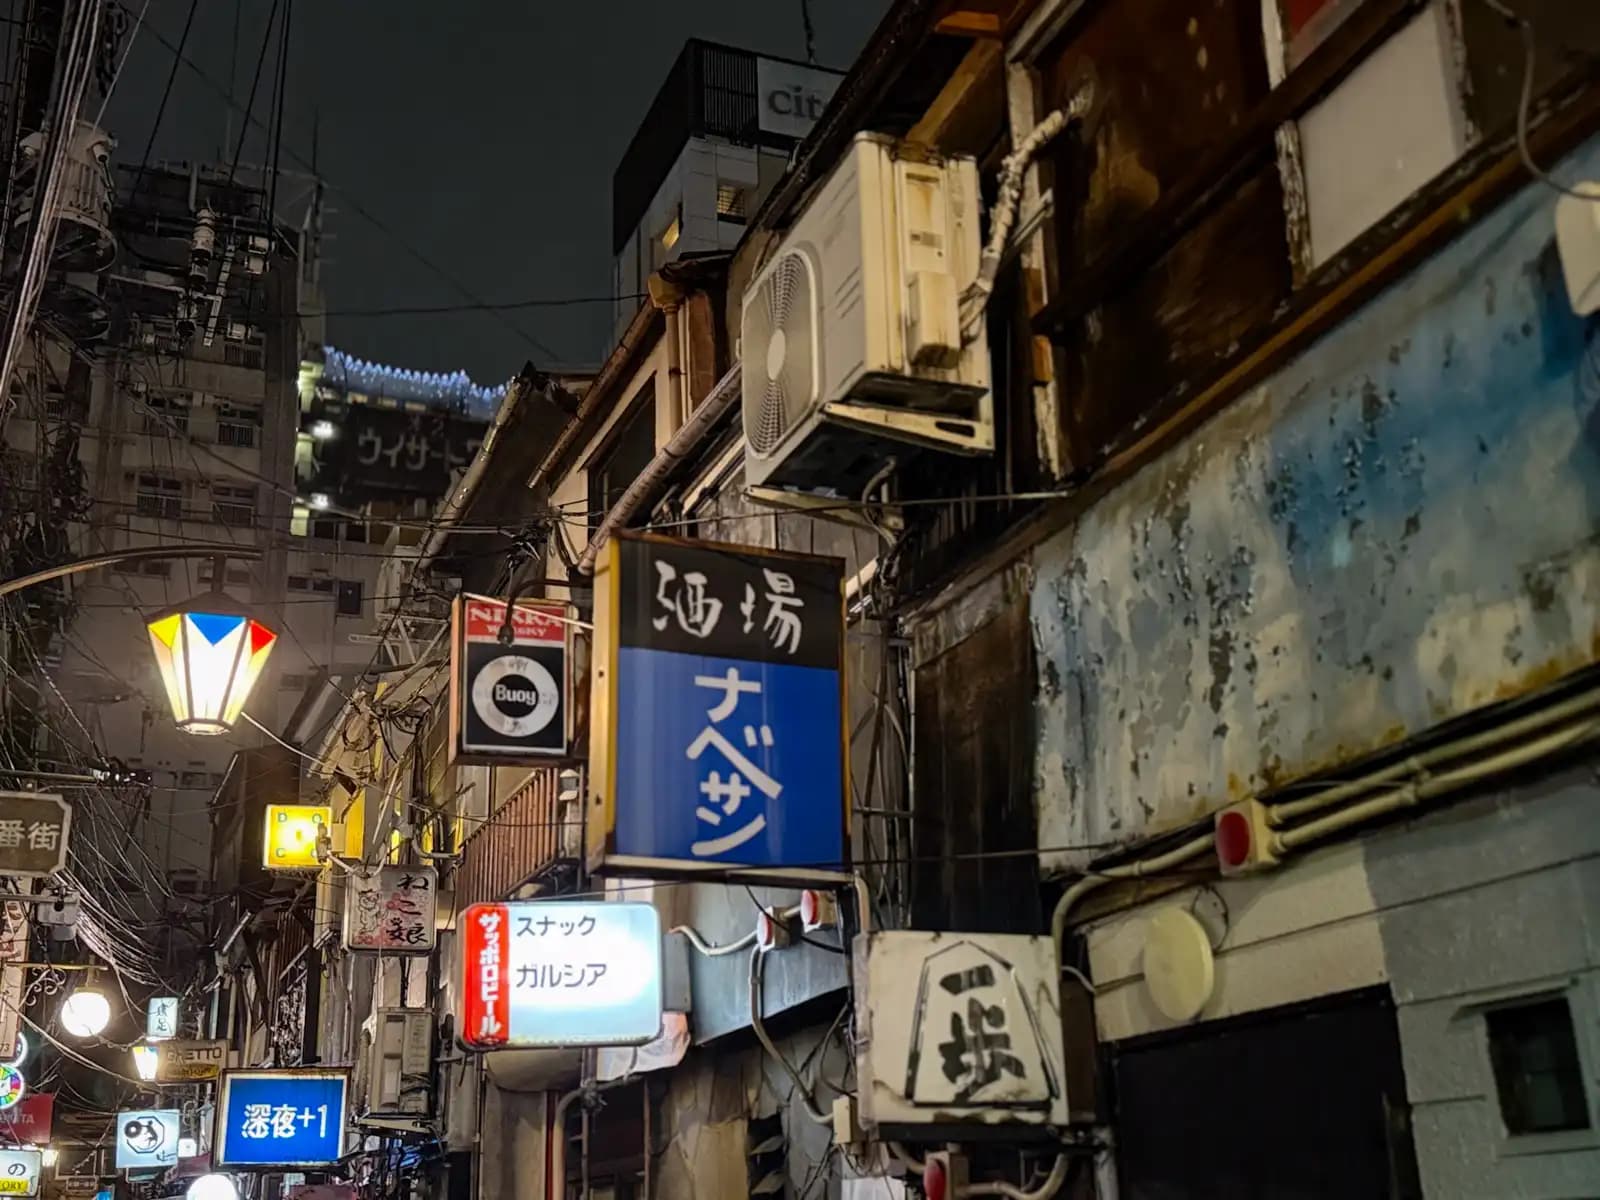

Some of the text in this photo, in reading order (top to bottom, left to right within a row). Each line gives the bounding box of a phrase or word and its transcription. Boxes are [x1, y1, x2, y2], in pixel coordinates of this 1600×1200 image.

[653, 560, 804, 654] 酒場
[494, 683, 537, 706] Buoy
[687, 667, 784, 856] ナベサン
[0, 820, 60, 851] 番街
[516, 915, 597, 938] スナック
[478, 912, 502, 1039] サッポロビール
[515, 963, 608, 989] ガルシア
[938, 964, 1026, 1102] 一歩
[241, 1103, 328, 1139] 深夜+1
